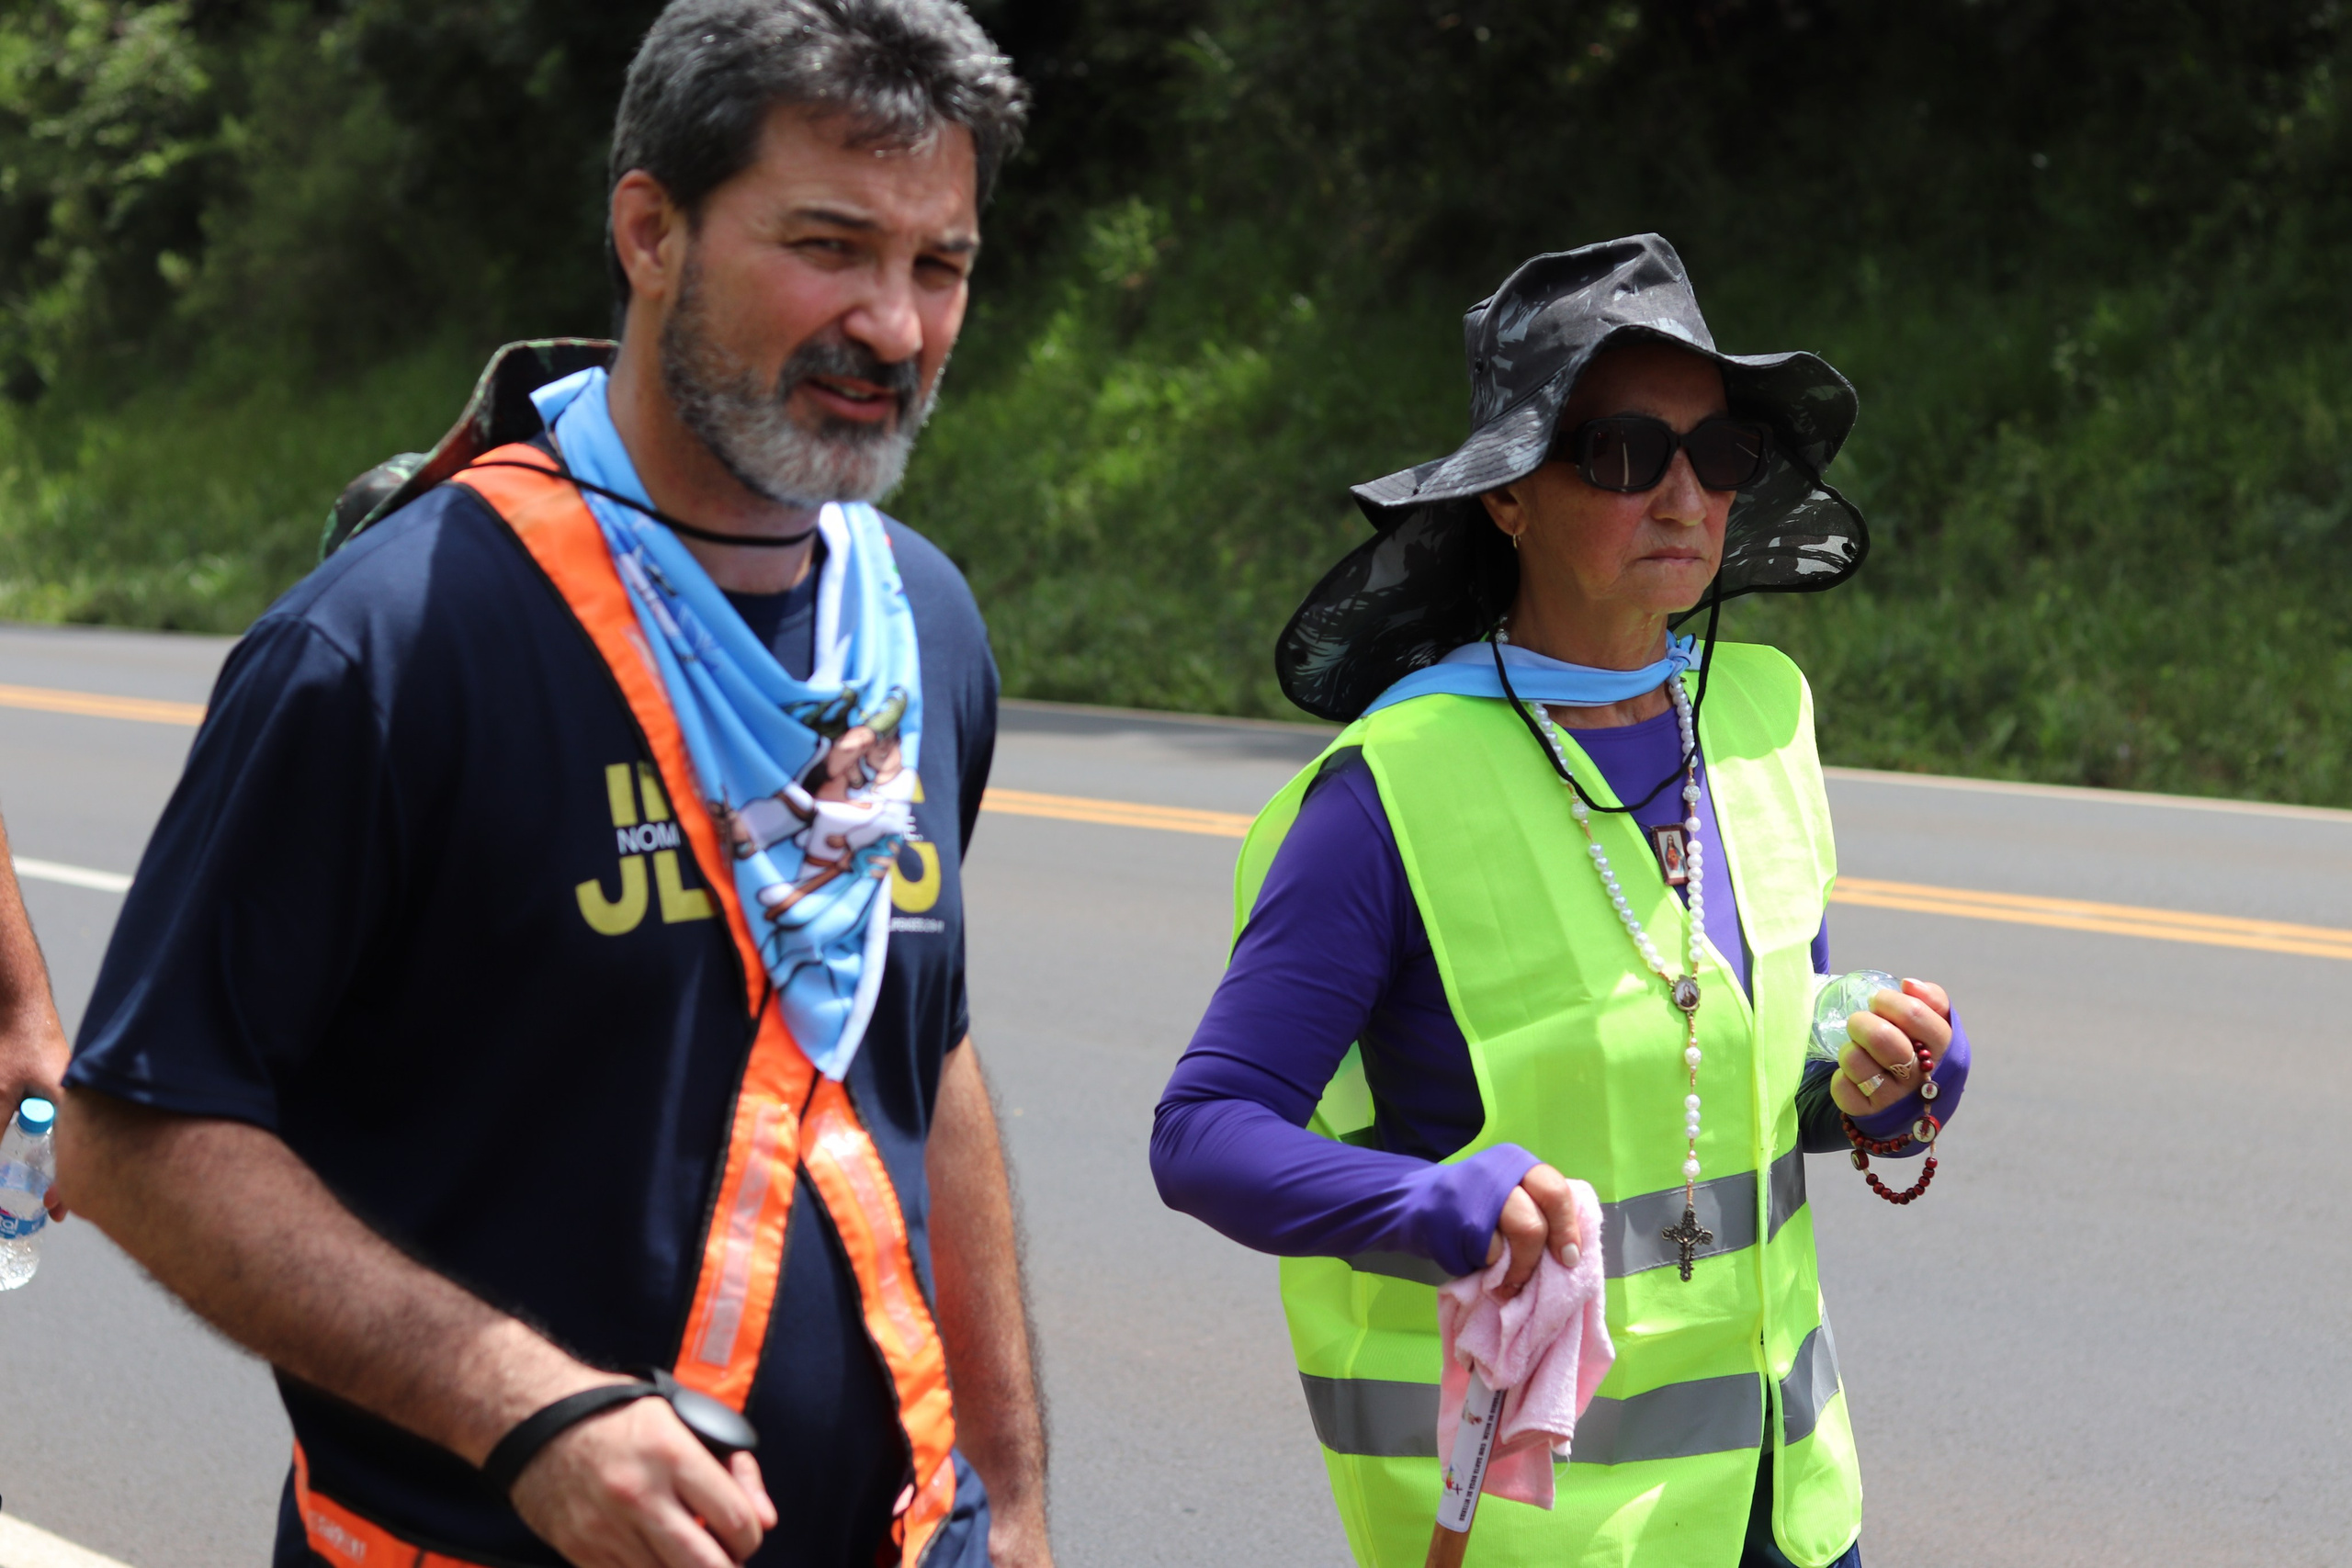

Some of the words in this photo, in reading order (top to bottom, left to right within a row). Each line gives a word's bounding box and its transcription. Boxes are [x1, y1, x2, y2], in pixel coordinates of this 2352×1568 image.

[616, 821, 682, 856] NOM
[1478, 1443, 1487, 1456] COM
[1473, 1457, 1483, 1473] SANTA
[1468, 1475, 1477, 1489] ROSA
